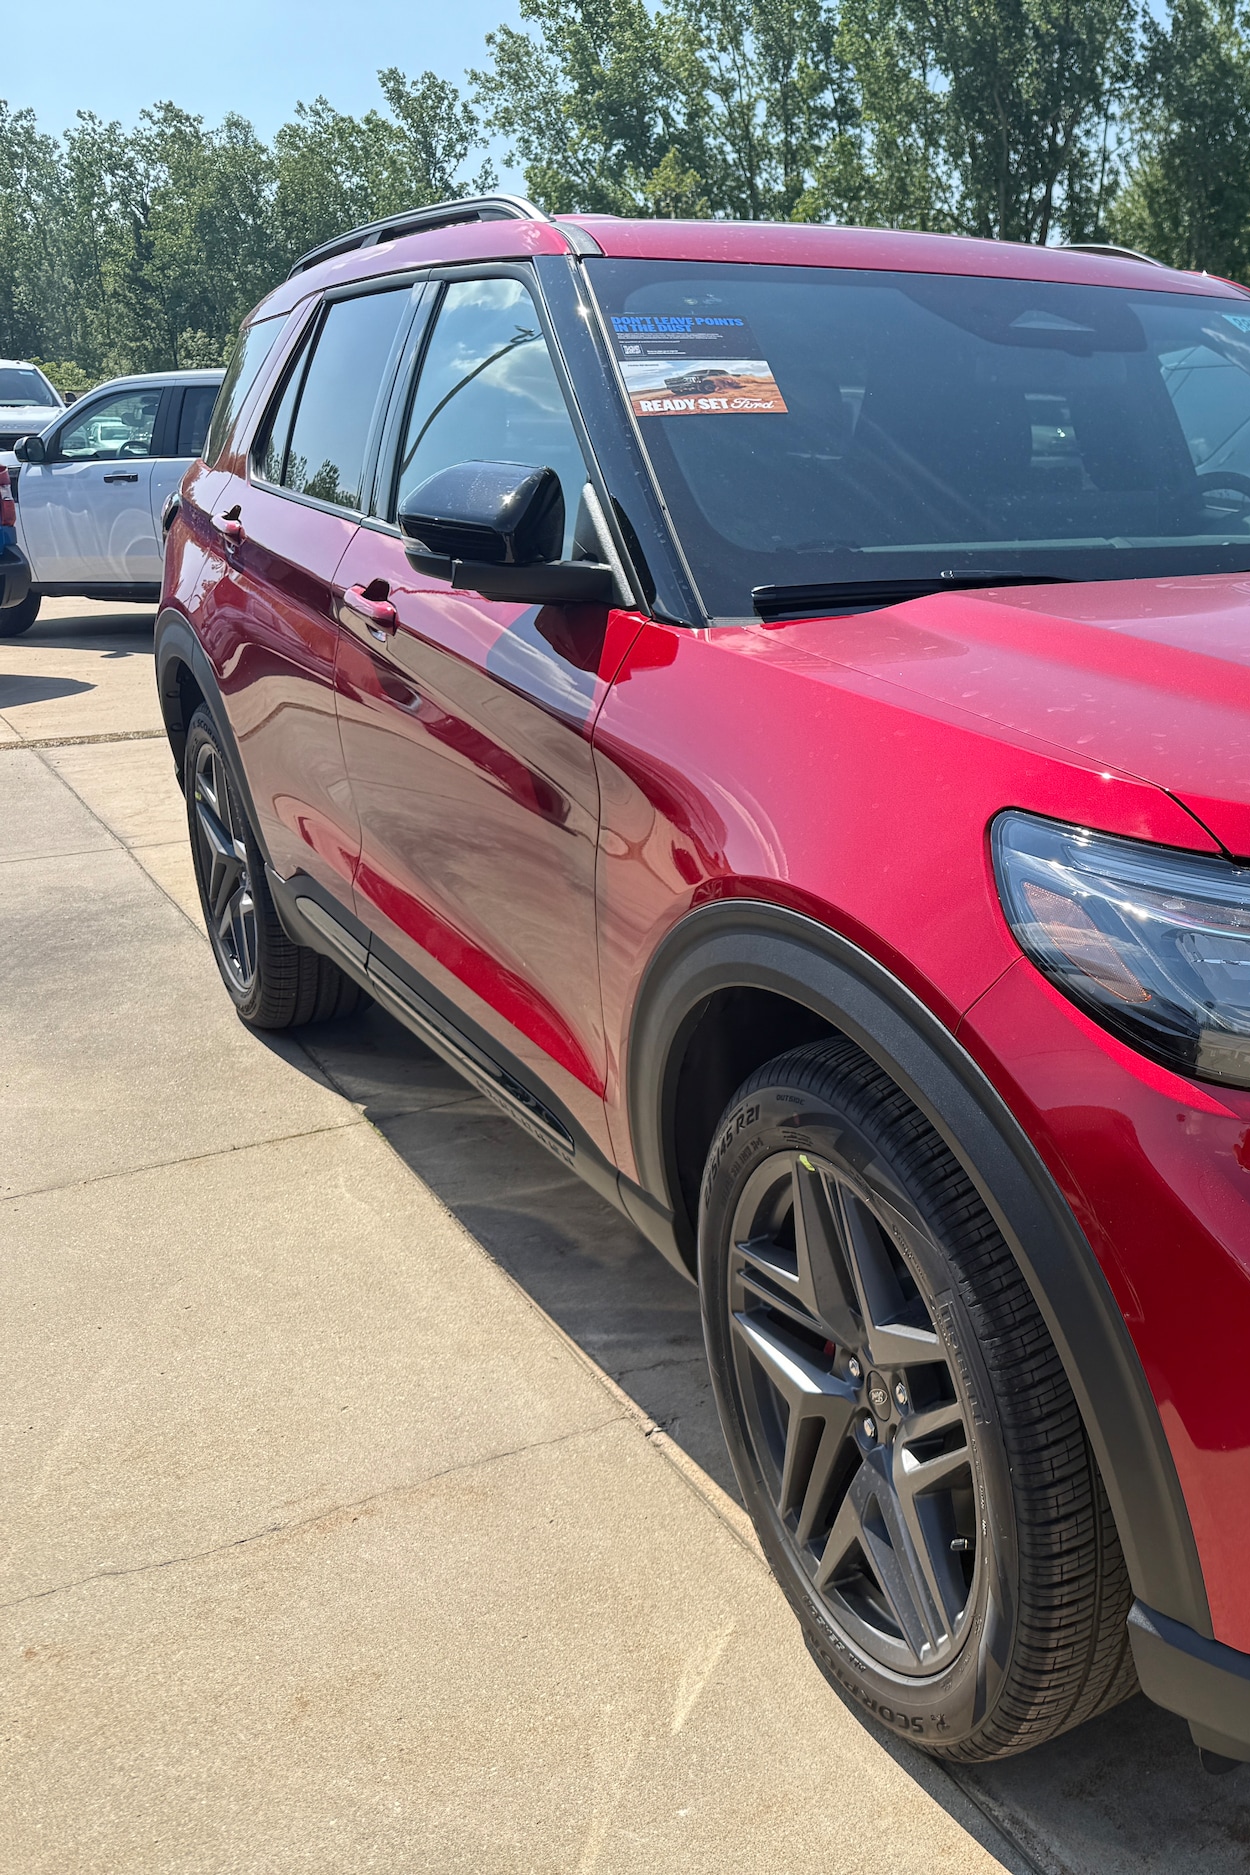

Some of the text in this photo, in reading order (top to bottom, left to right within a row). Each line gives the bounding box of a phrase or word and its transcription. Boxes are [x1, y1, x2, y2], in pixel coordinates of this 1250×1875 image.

[610, 316, 744, 327] DON'T LEAVE POINTS
[614, 324, 693, 333] IN THE DUST
[639, 397, 775, 412] READY SET Ford
[775, 1093, 806, 1106] OUTSIDE
[806, 1626, 924, 1733] SCORPION
